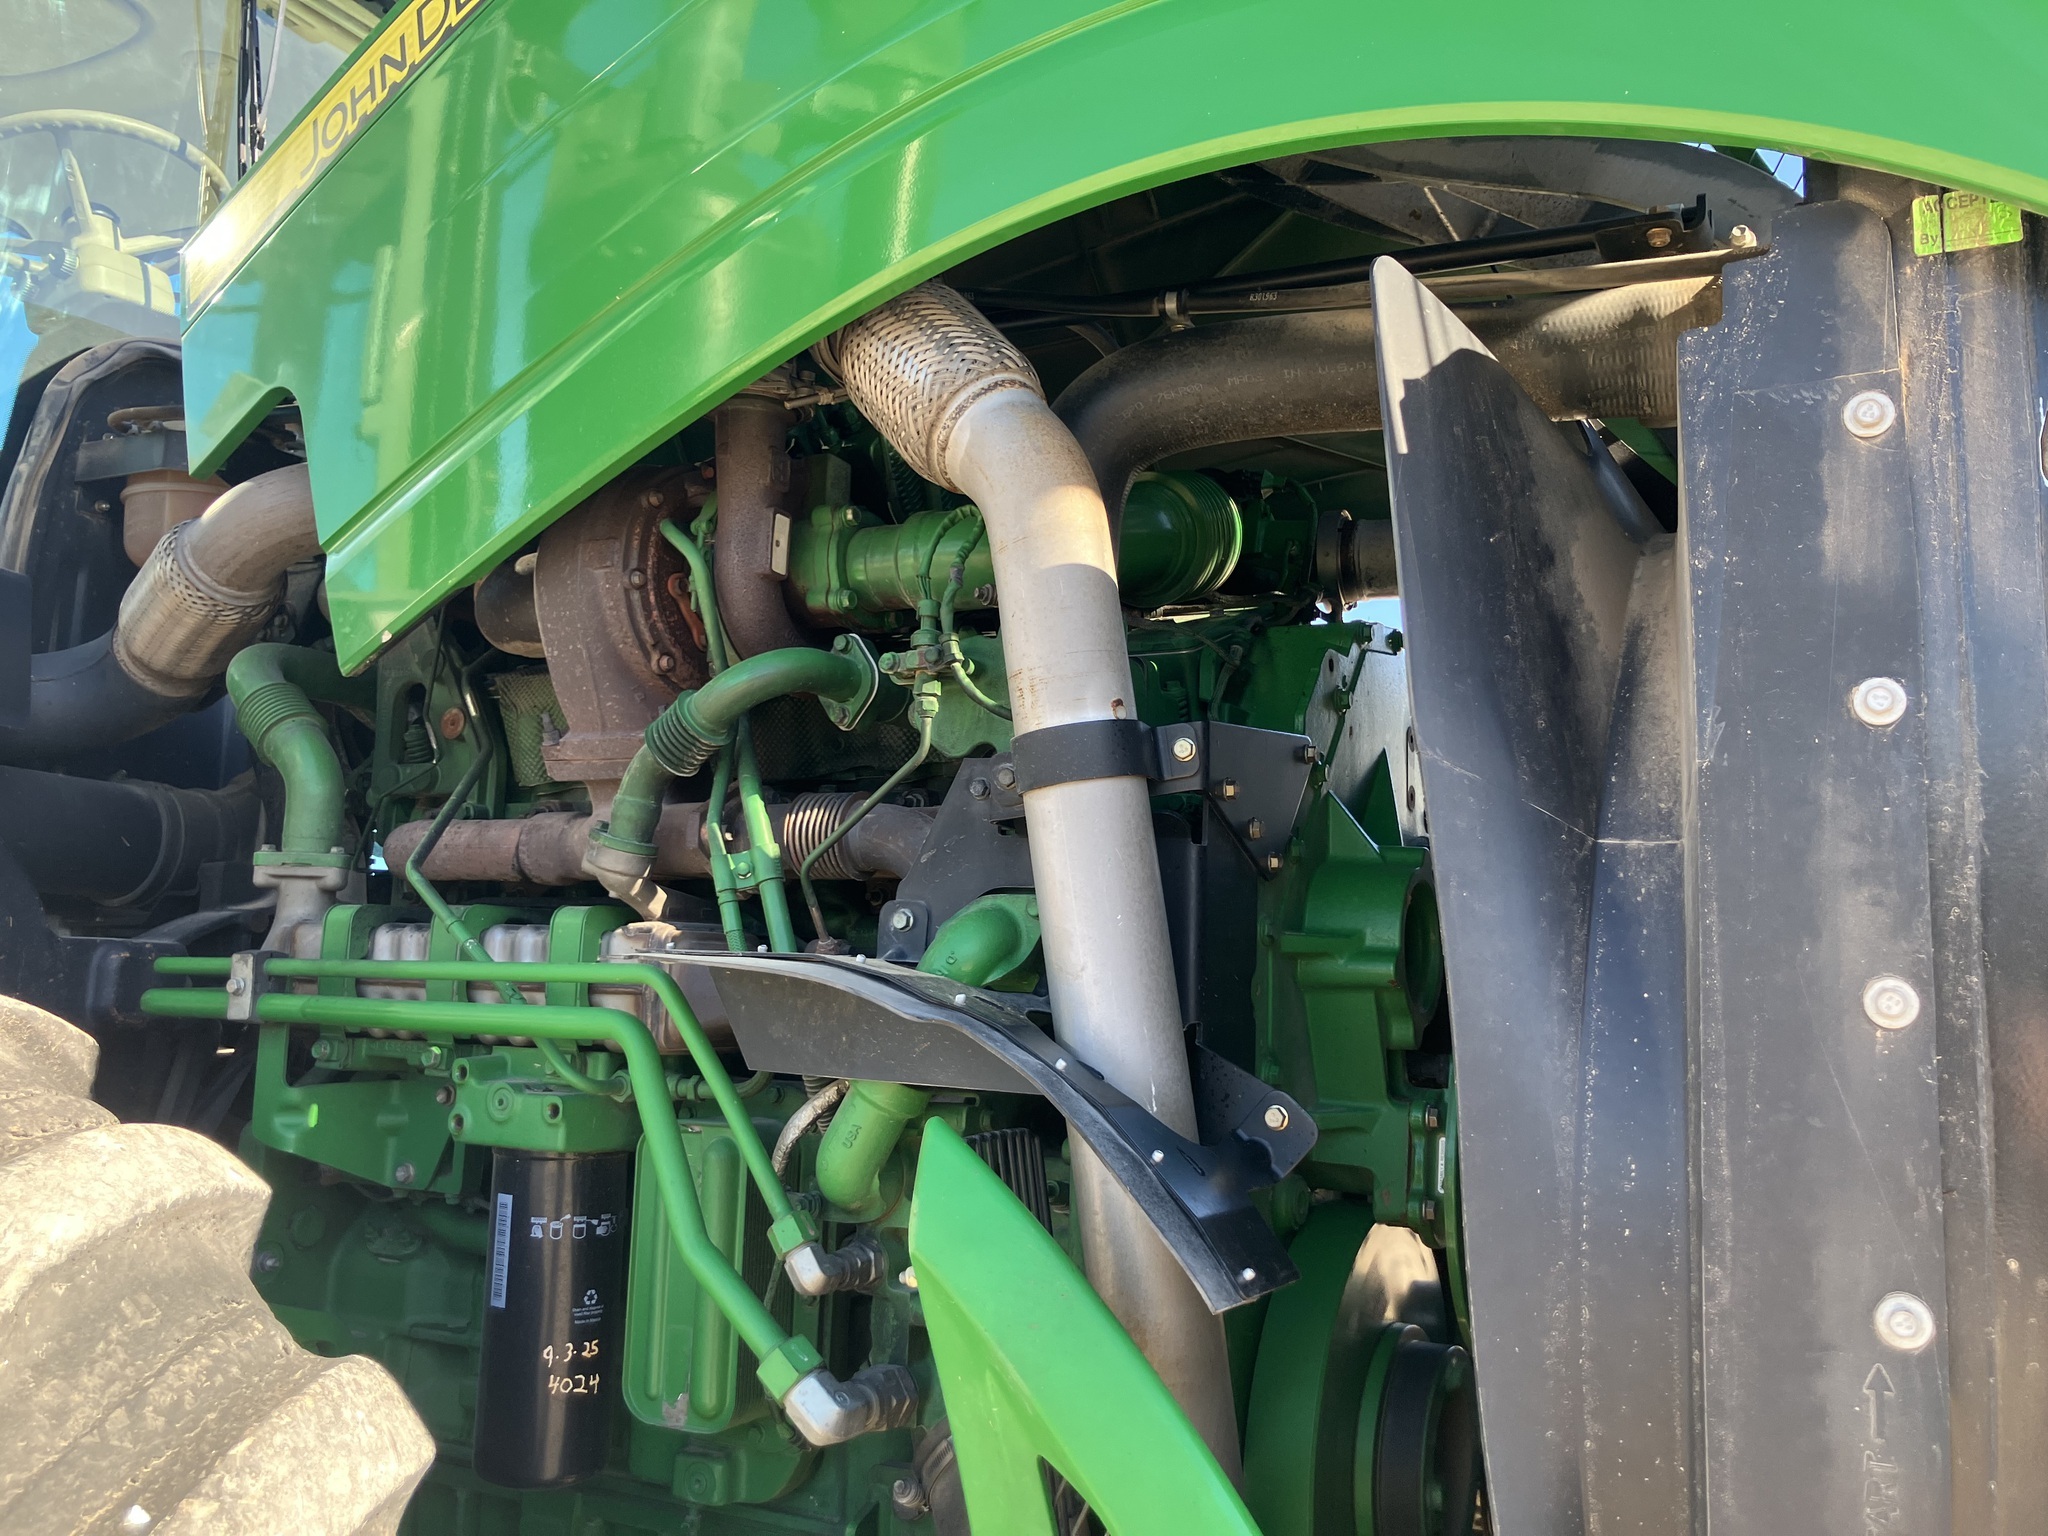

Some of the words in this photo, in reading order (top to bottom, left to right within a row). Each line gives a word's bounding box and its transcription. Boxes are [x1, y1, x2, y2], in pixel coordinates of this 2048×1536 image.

[300, 33, 407, 178] JOHN
[1920, 233, 1938, 247] By
[1284, 368, 1300, 379] IN
[842, 1123, 862, 1149] USA
[548, 1373, 600, 1395] 4024
